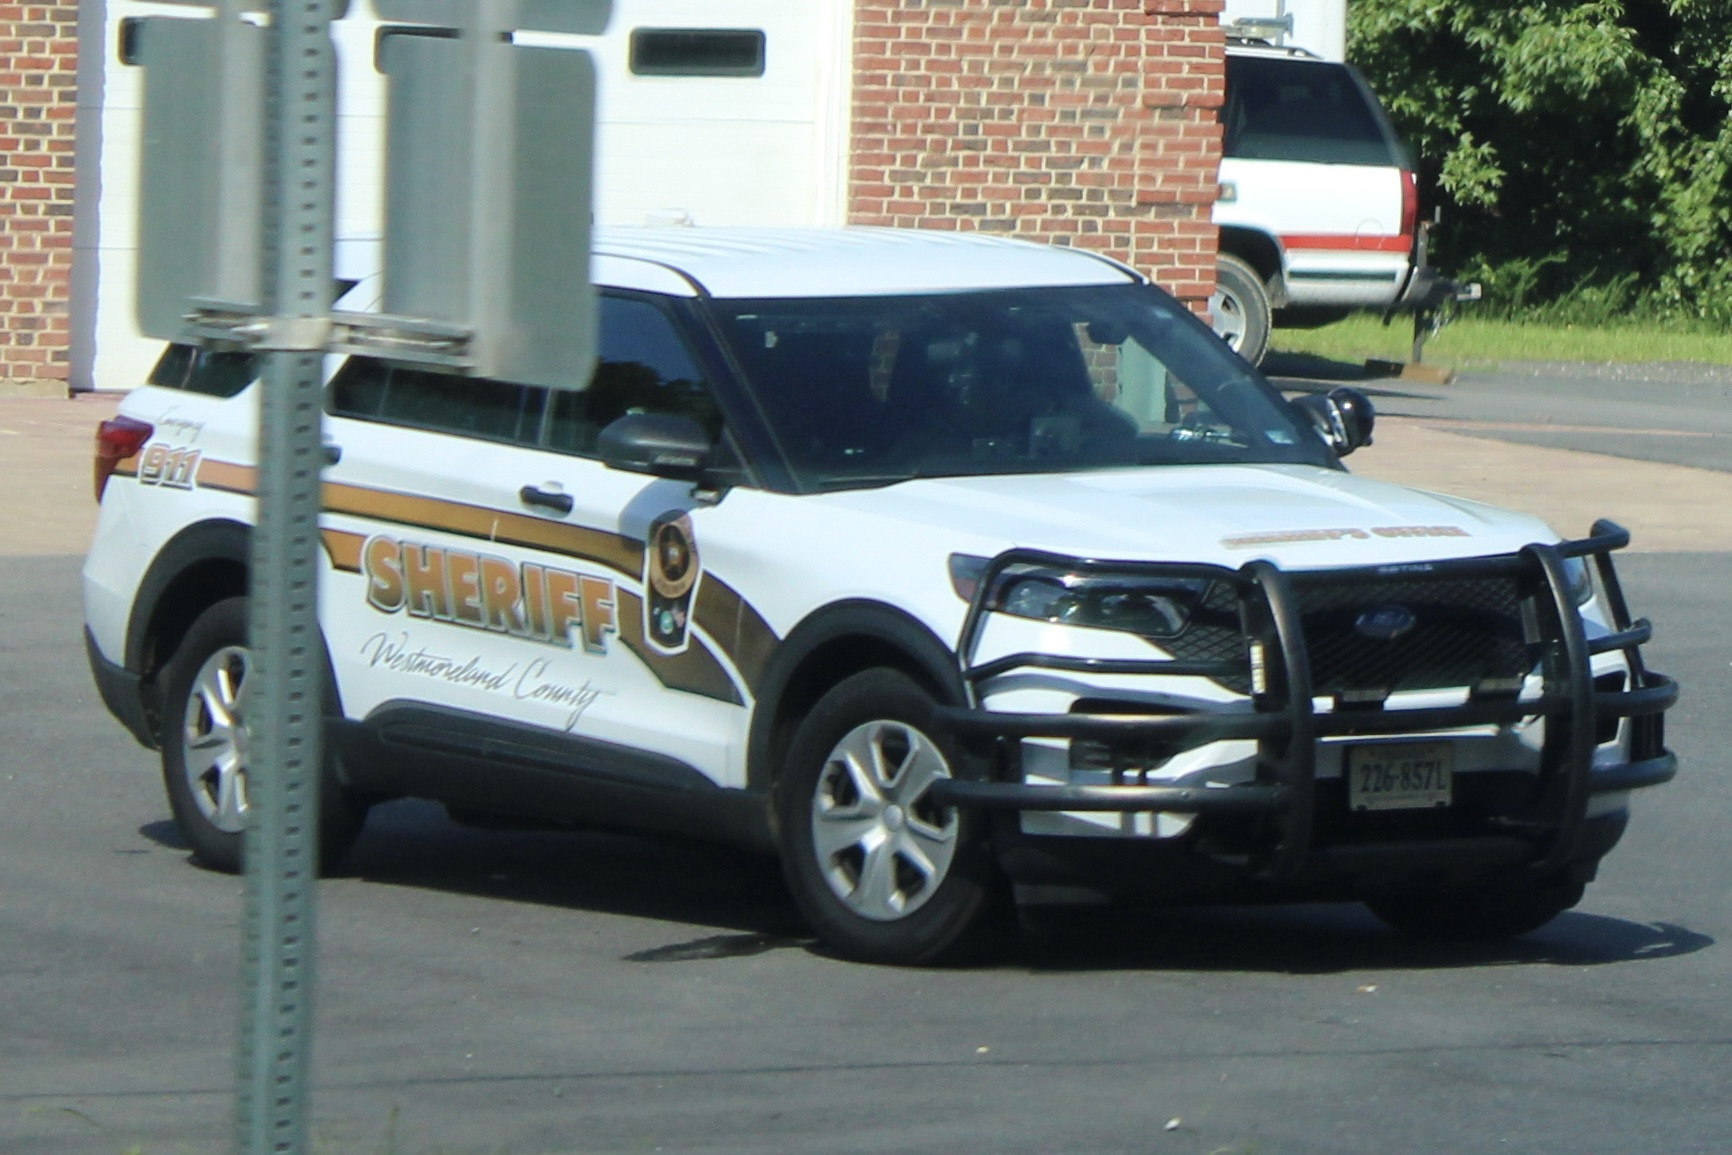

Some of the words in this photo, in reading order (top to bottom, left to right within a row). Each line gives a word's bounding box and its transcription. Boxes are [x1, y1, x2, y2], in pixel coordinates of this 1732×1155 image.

[140, 442, 201, 491] 911
[365, 534, 616, 654] SHERIFF
[361, 630, 518, 691] Westmoreland
[514, 656, 617, 733] County
[1361, 761, 1448, 793] 226-857L
